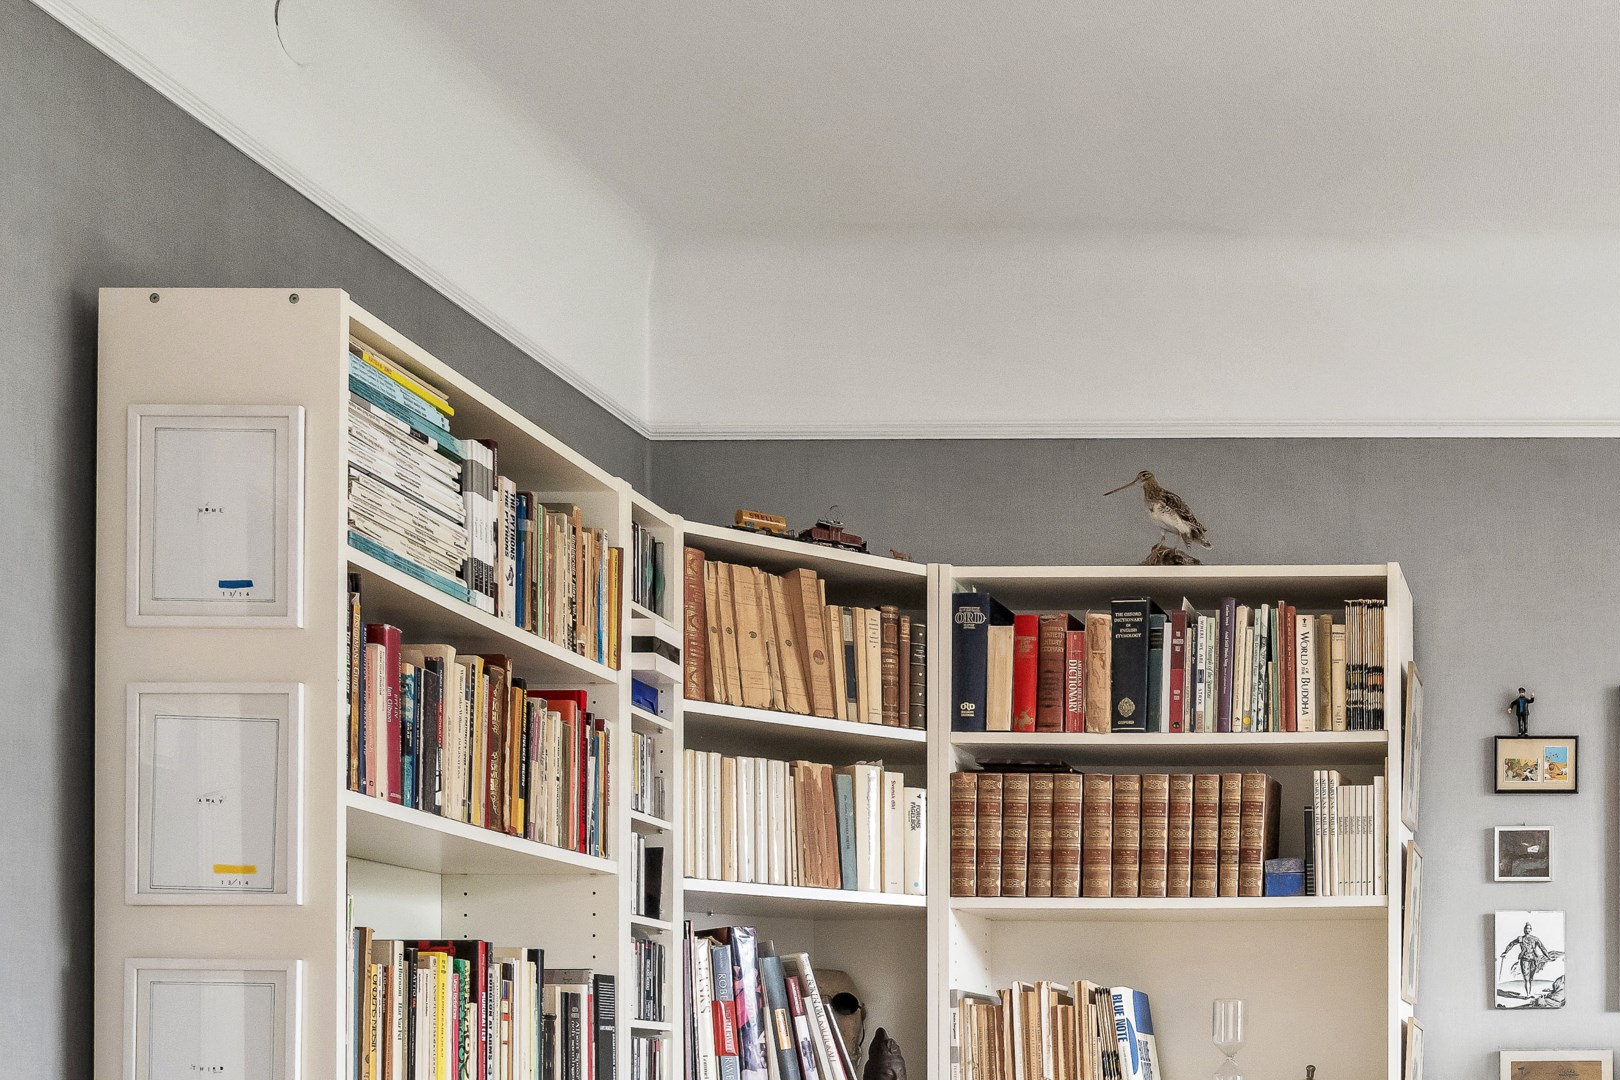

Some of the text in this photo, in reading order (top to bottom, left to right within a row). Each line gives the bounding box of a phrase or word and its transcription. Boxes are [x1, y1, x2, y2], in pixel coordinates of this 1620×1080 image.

[748, 511, 780, 523] SHELL
[955, 611, 986, 625] ORD
[1199, 642, 1205, 651] WE
[1068, 659, 1078, 714] DICTIONARY
[1300, 631, 1311, 716] WORLD BUDDHA
[1112, 994, 1128, 1043] BLUE NOTE
